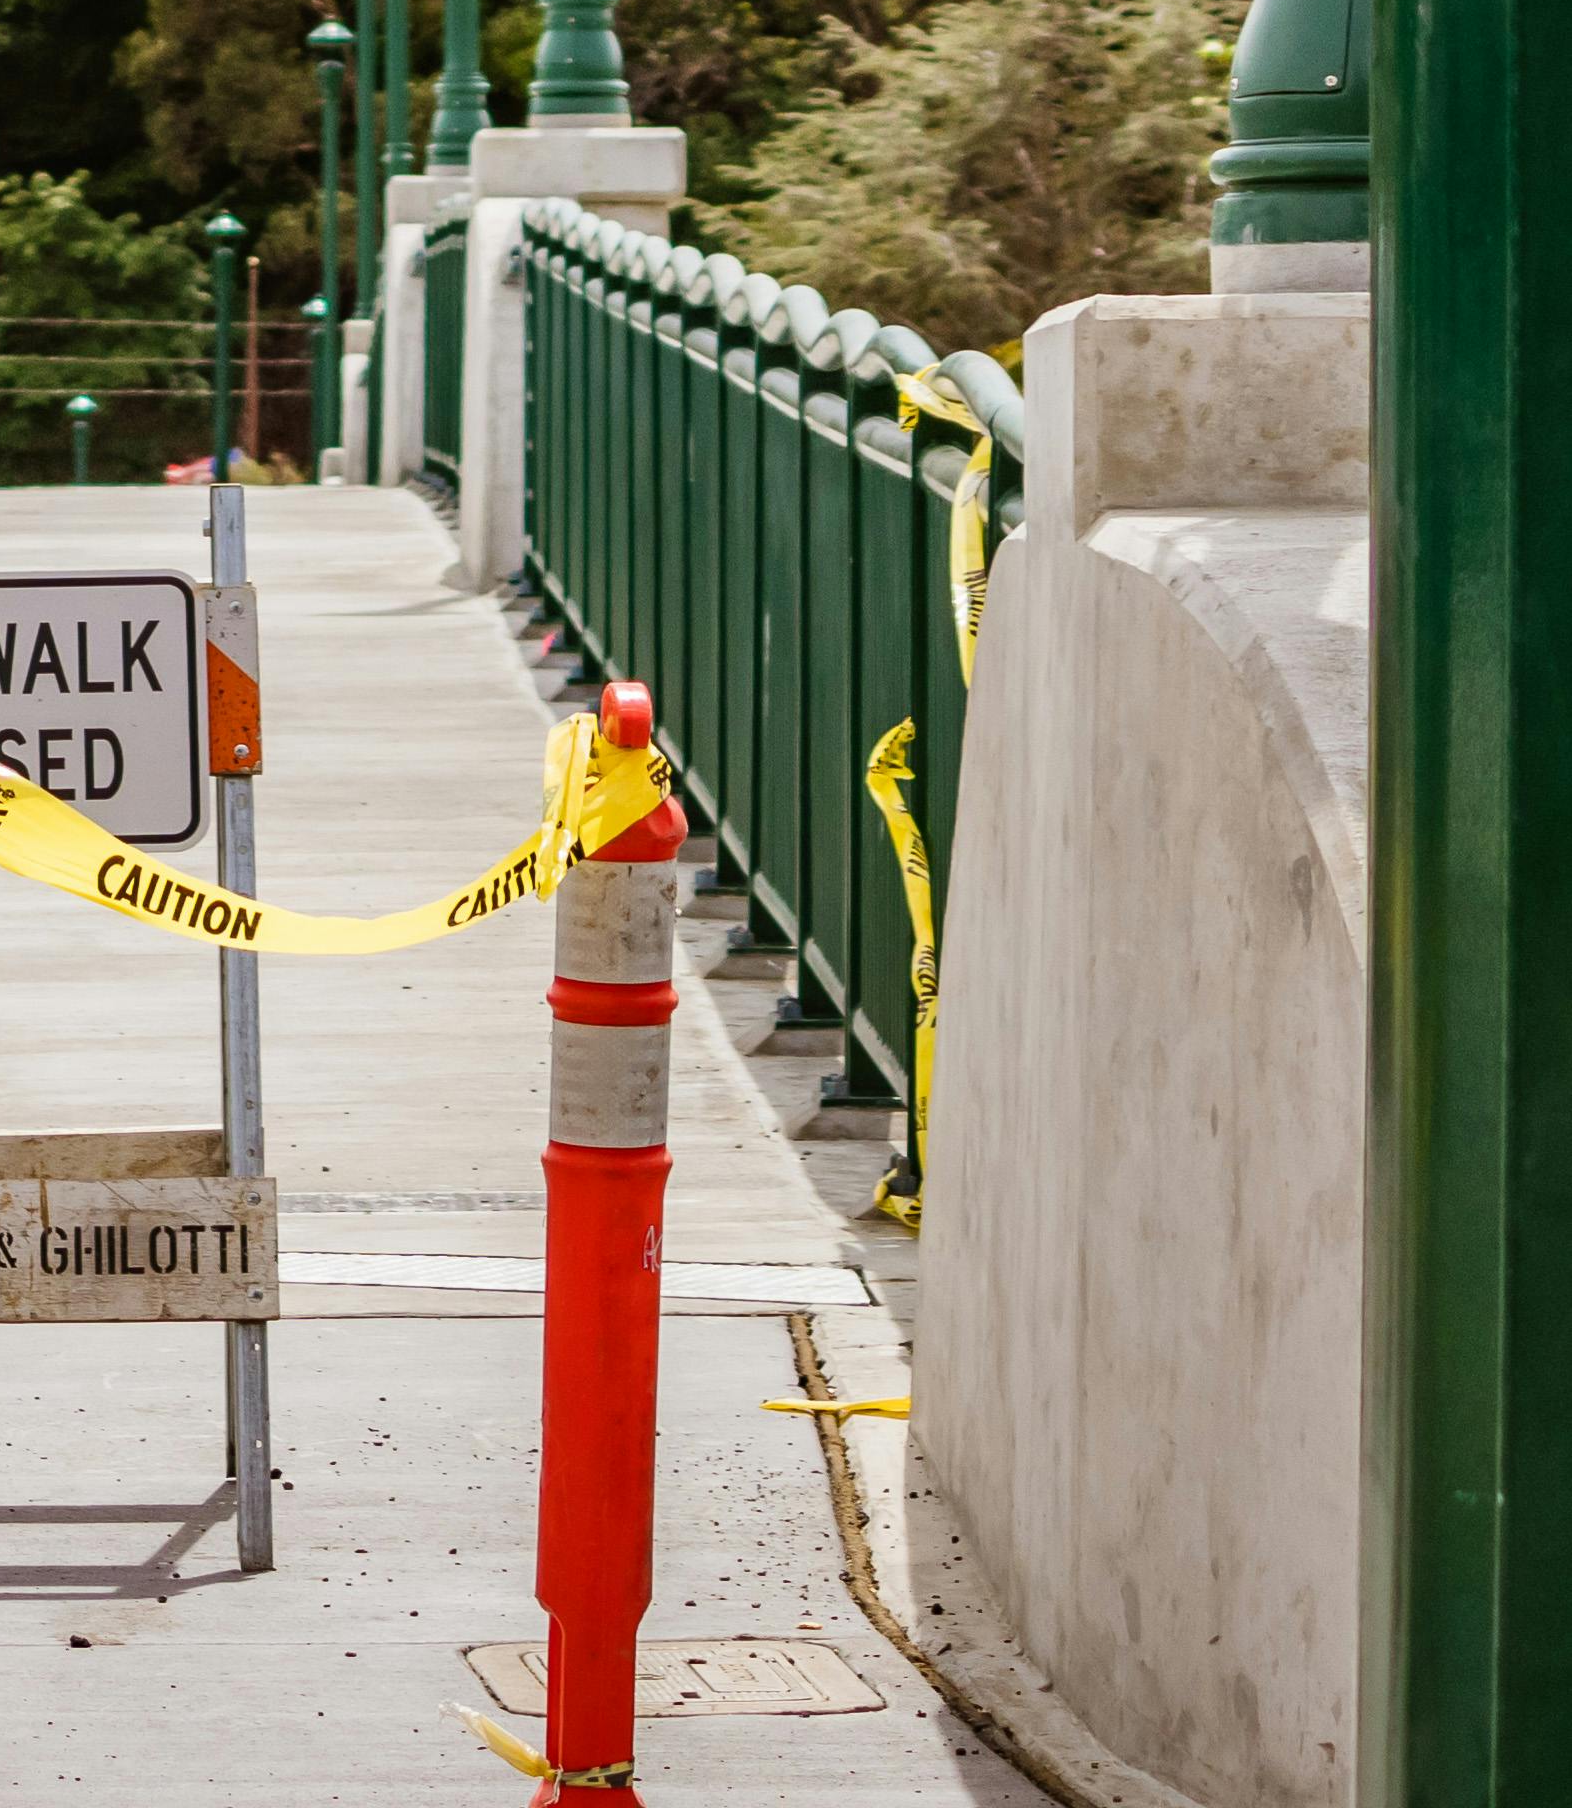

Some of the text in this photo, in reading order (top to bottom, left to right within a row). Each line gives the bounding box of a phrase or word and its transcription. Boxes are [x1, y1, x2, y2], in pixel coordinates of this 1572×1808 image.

[97, 854, 263, 941] CAUTION
[447, 835, 587, 927] CAUTIN
[39, 1224, 249, 1275] GHILOTTI
